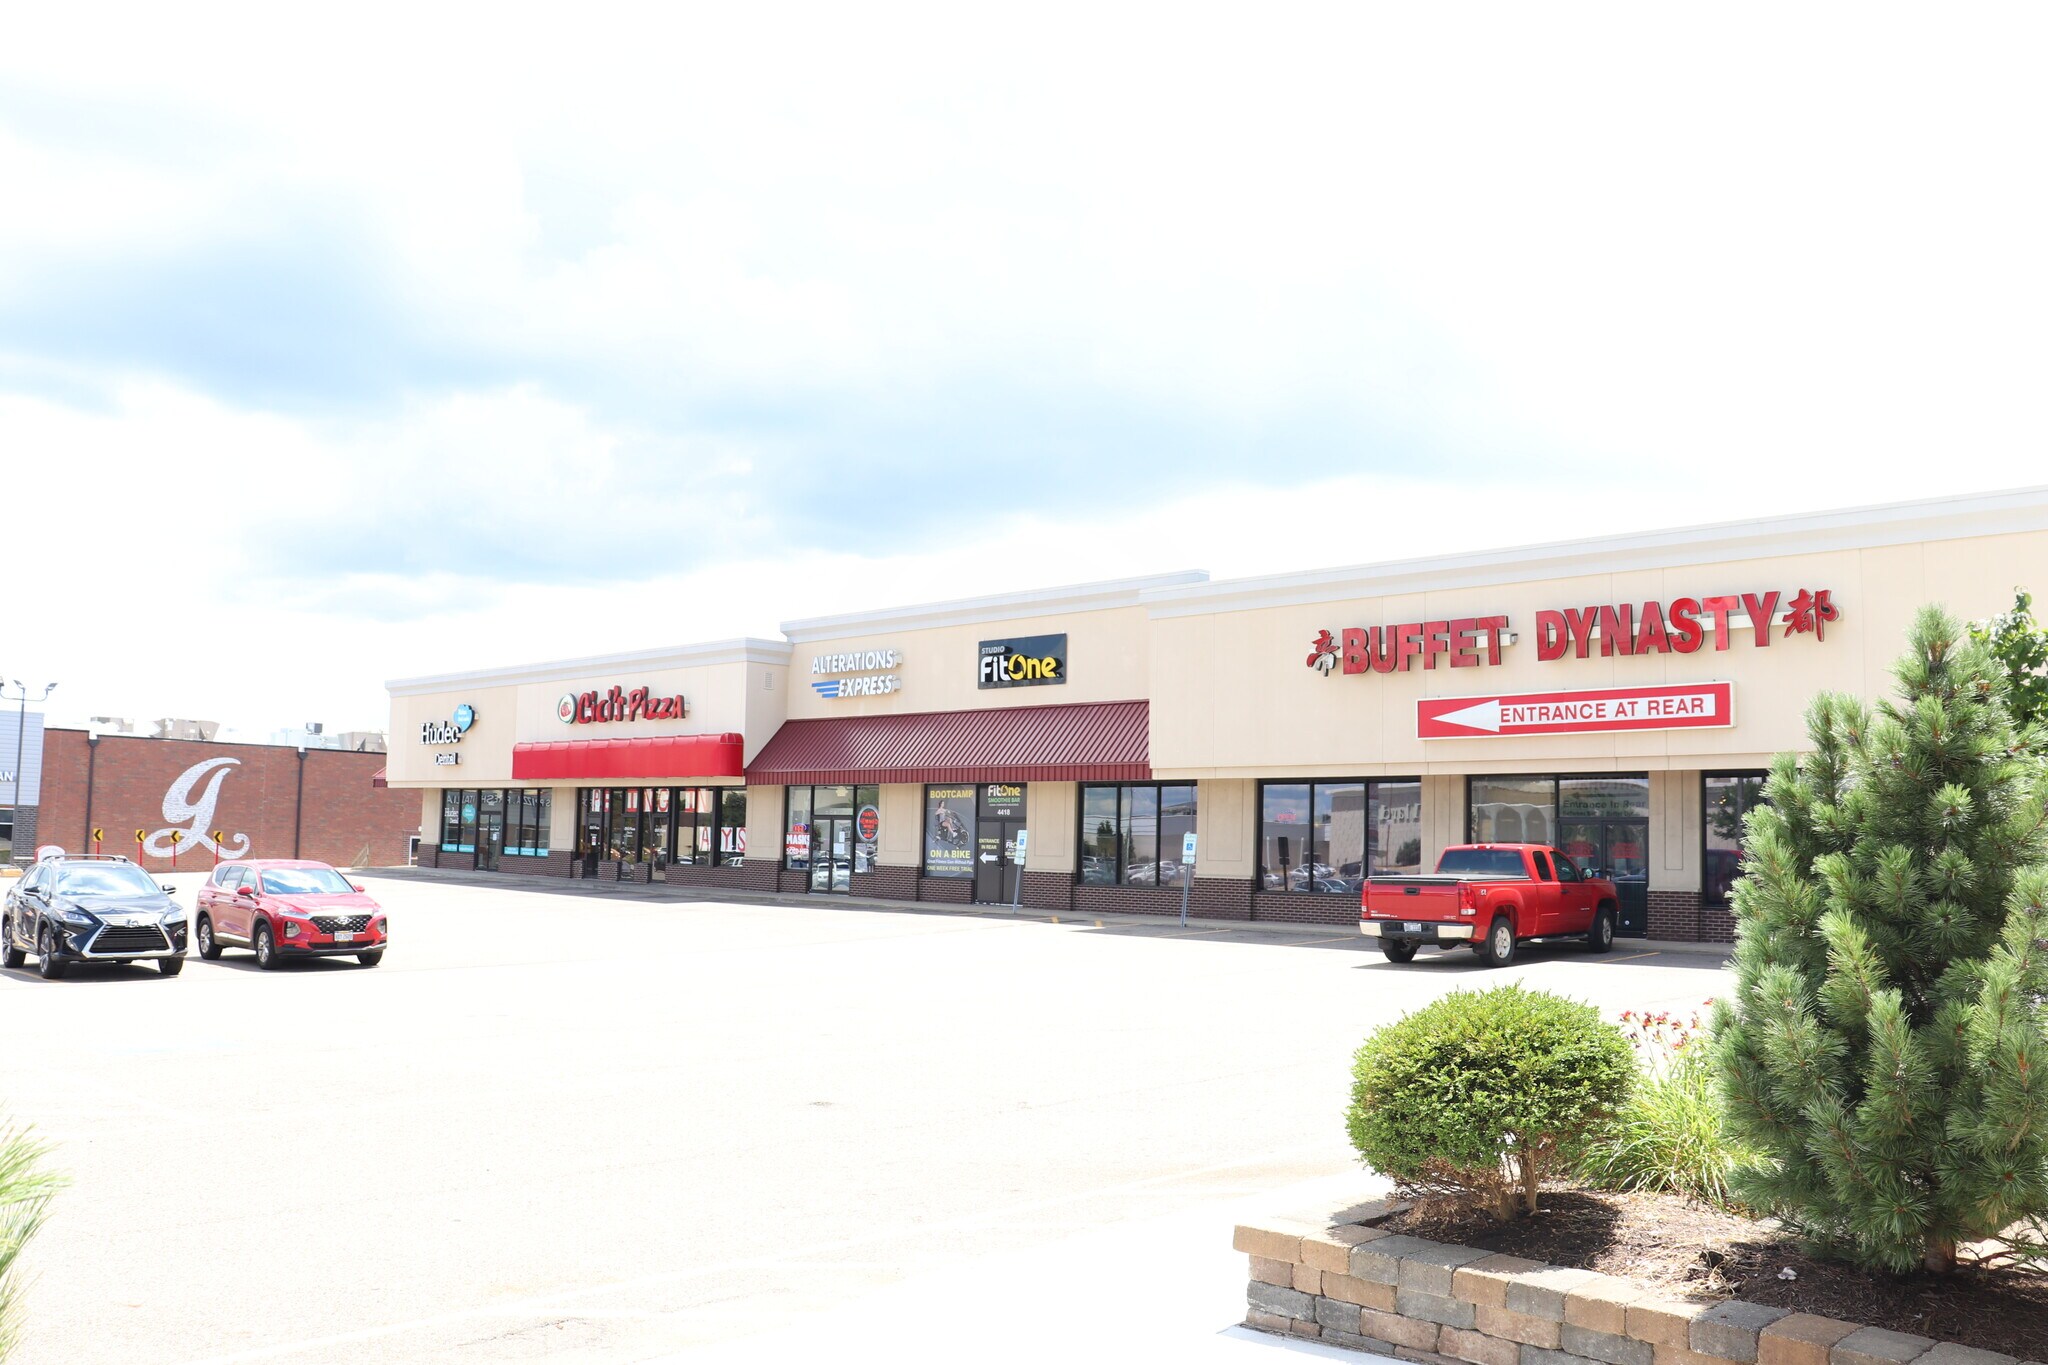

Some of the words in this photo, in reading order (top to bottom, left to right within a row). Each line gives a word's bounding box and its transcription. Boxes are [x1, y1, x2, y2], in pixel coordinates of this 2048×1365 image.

[1783, 588, 1840, 642] 都
[1342, 615, 1509, 675] BUFFET
[1535, 591, 1781, 662] DYNASTY
[981, 646, 1005, 654] STUDIO
[811, 650, 895, 675] ALTERATIONS
[980, 653, 1058, 682] FitOne
[837, 674, 894, 697] EXPRESS
[1500, 702, 1607, 723] ENTRANCE
[1614, 701, 1639, 717] AT
[1647, 697, 1705, 716] REAR
[420, 721, 461, 744] Hudec
[930, 789, 974, 799] BOOTCAMP
[987, 784, 1021, 797] FitOne
[930, 849, 942, 858] ON
[943, 850, 950, 858] A
[951, 850, 971, 859] BIKE
